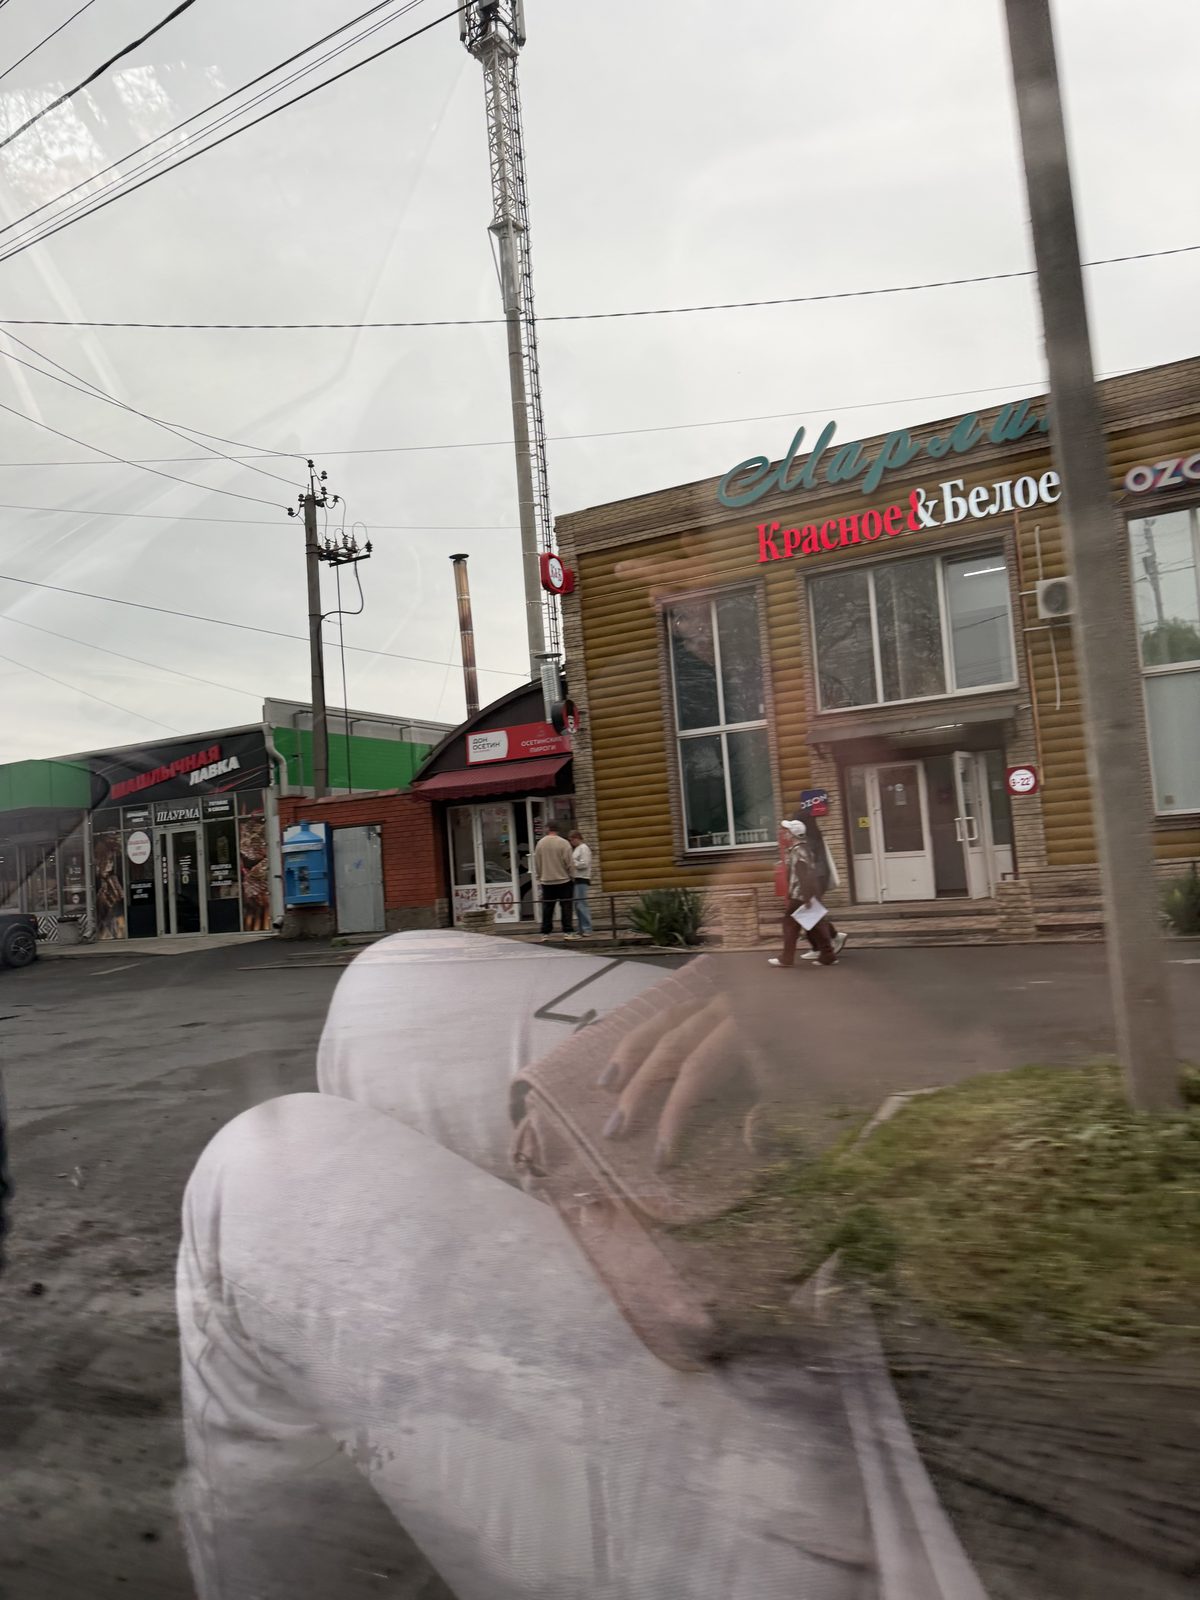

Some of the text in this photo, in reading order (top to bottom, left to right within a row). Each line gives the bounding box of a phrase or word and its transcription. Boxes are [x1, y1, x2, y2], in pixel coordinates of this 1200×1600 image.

[717, 400, 1050, 507] Марли
[472, 741, 500, 750] ОСЕТИН
[111, 744, 221, 799] ШАШЛЫЧНАЯ
[189, 755, 240, 786] ЛАВКА
[156, 808, 200, 822] ШАУРМА
